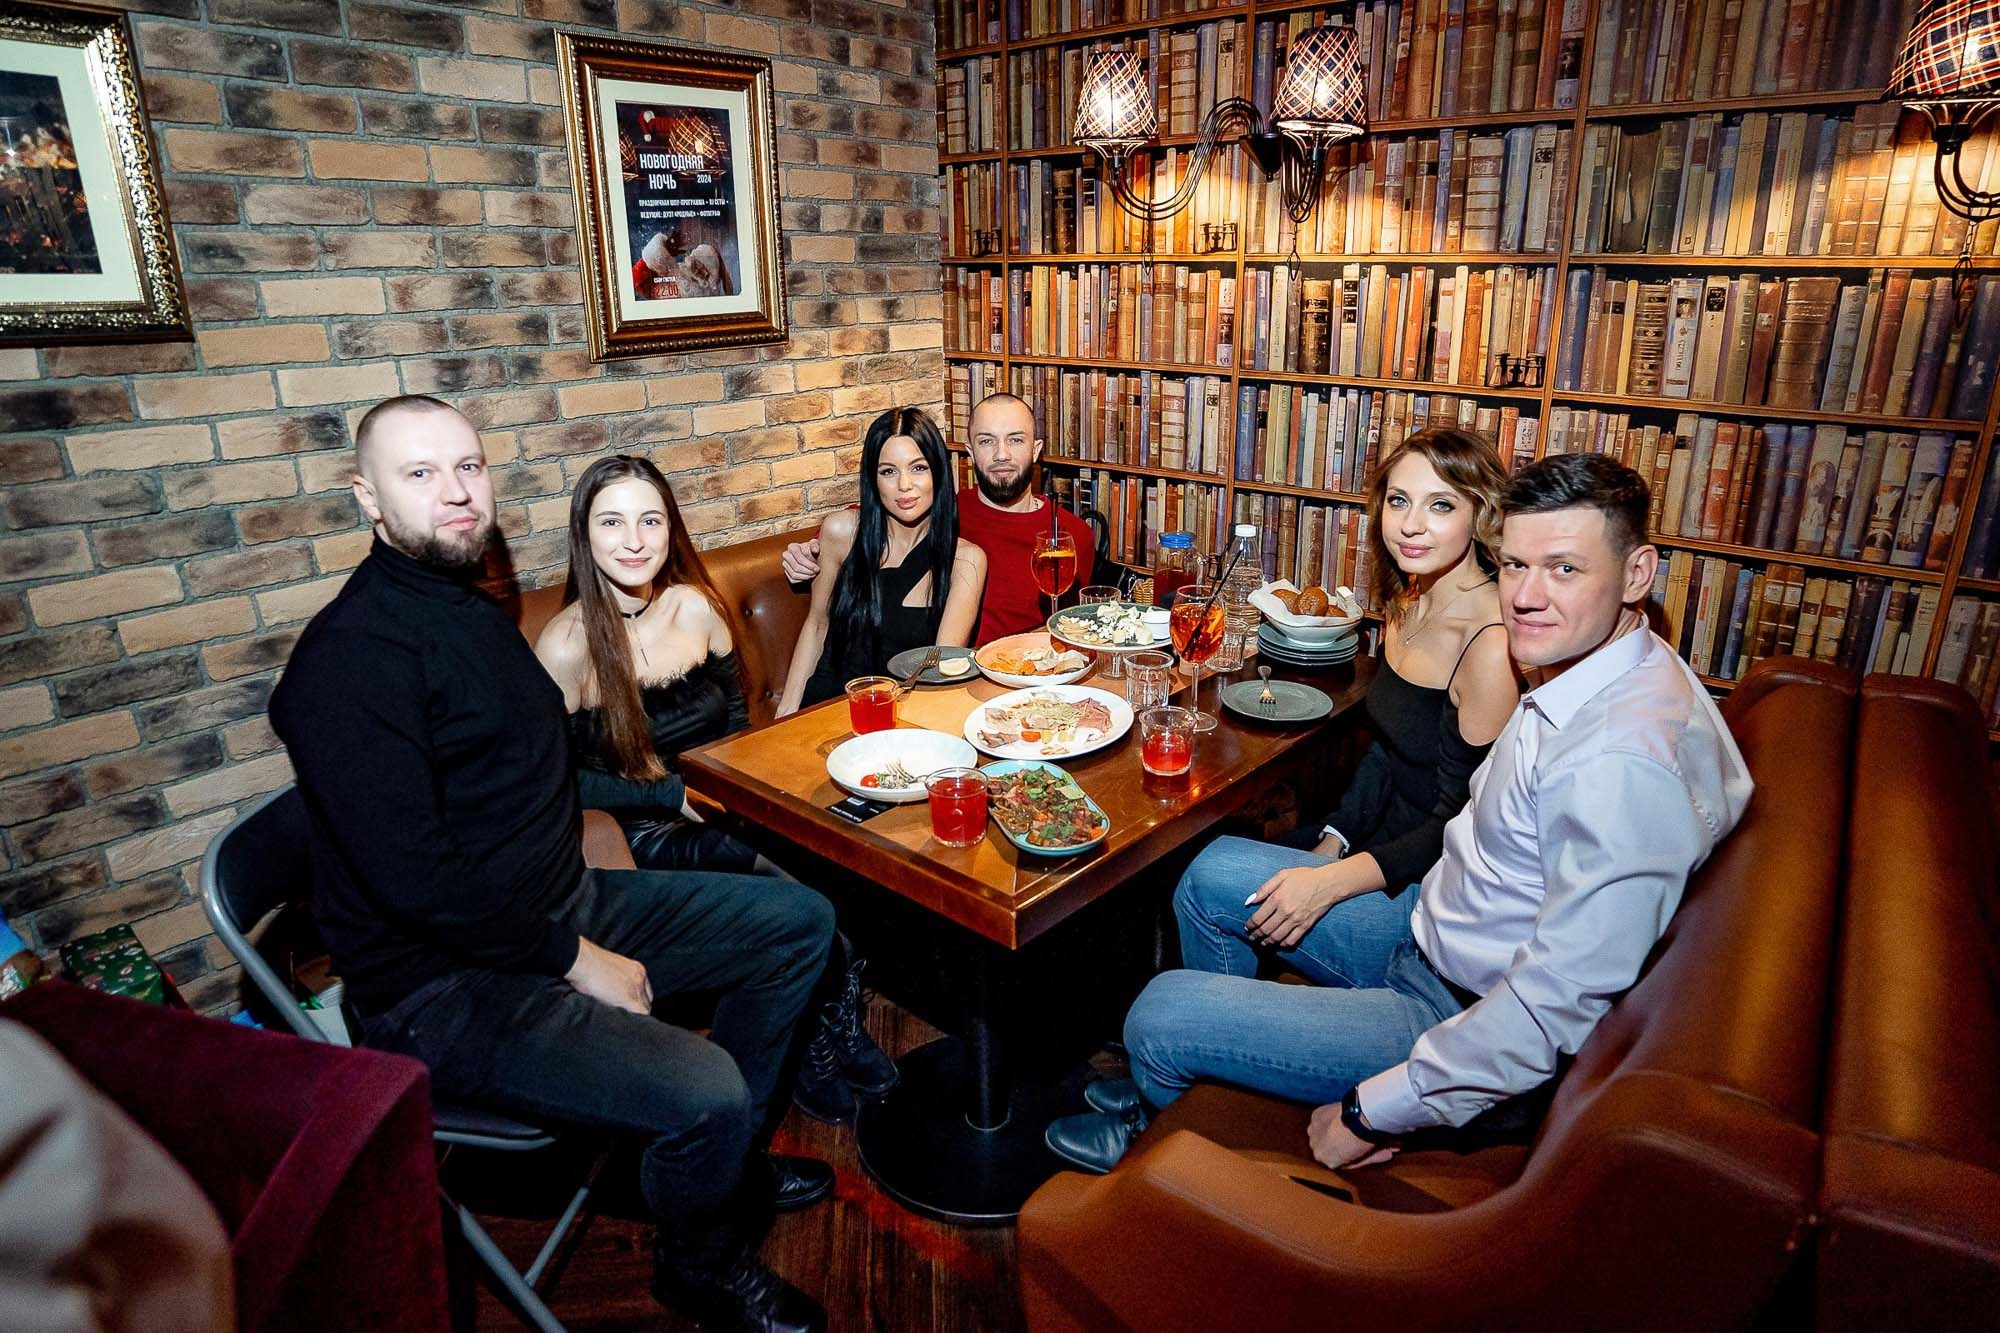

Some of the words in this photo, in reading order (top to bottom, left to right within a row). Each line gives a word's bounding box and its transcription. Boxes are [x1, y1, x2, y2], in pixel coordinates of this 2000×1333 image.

[639, 153, 704, 170] НОВОГОДНЯЯ
[649, 173, 677, 190] НОЧЬ
[697, 174, 712, 184] 2024
[655, 284, 678, 297] 22:00
